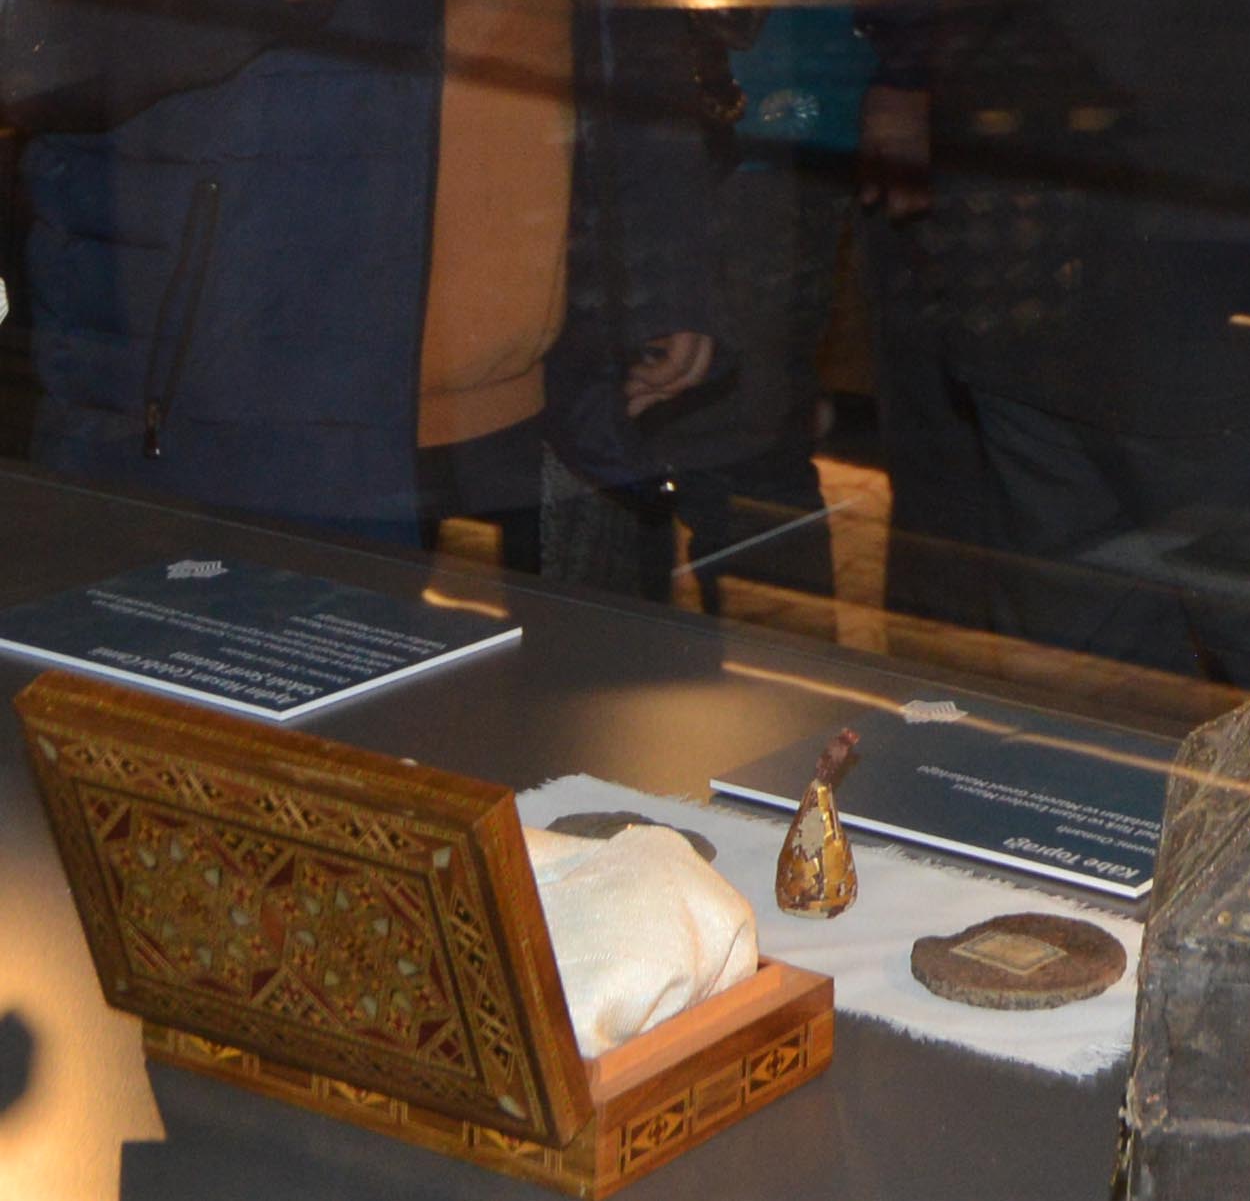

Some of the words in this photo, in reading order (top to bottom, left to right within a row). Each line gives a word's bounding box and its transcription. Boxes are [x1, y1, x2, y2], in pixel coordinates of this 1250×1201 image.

[1082, 805, 1099, 815] ve
[1086, 816, 1104, 826] ve
[1002, 837, 1082, 864] Toprağı
